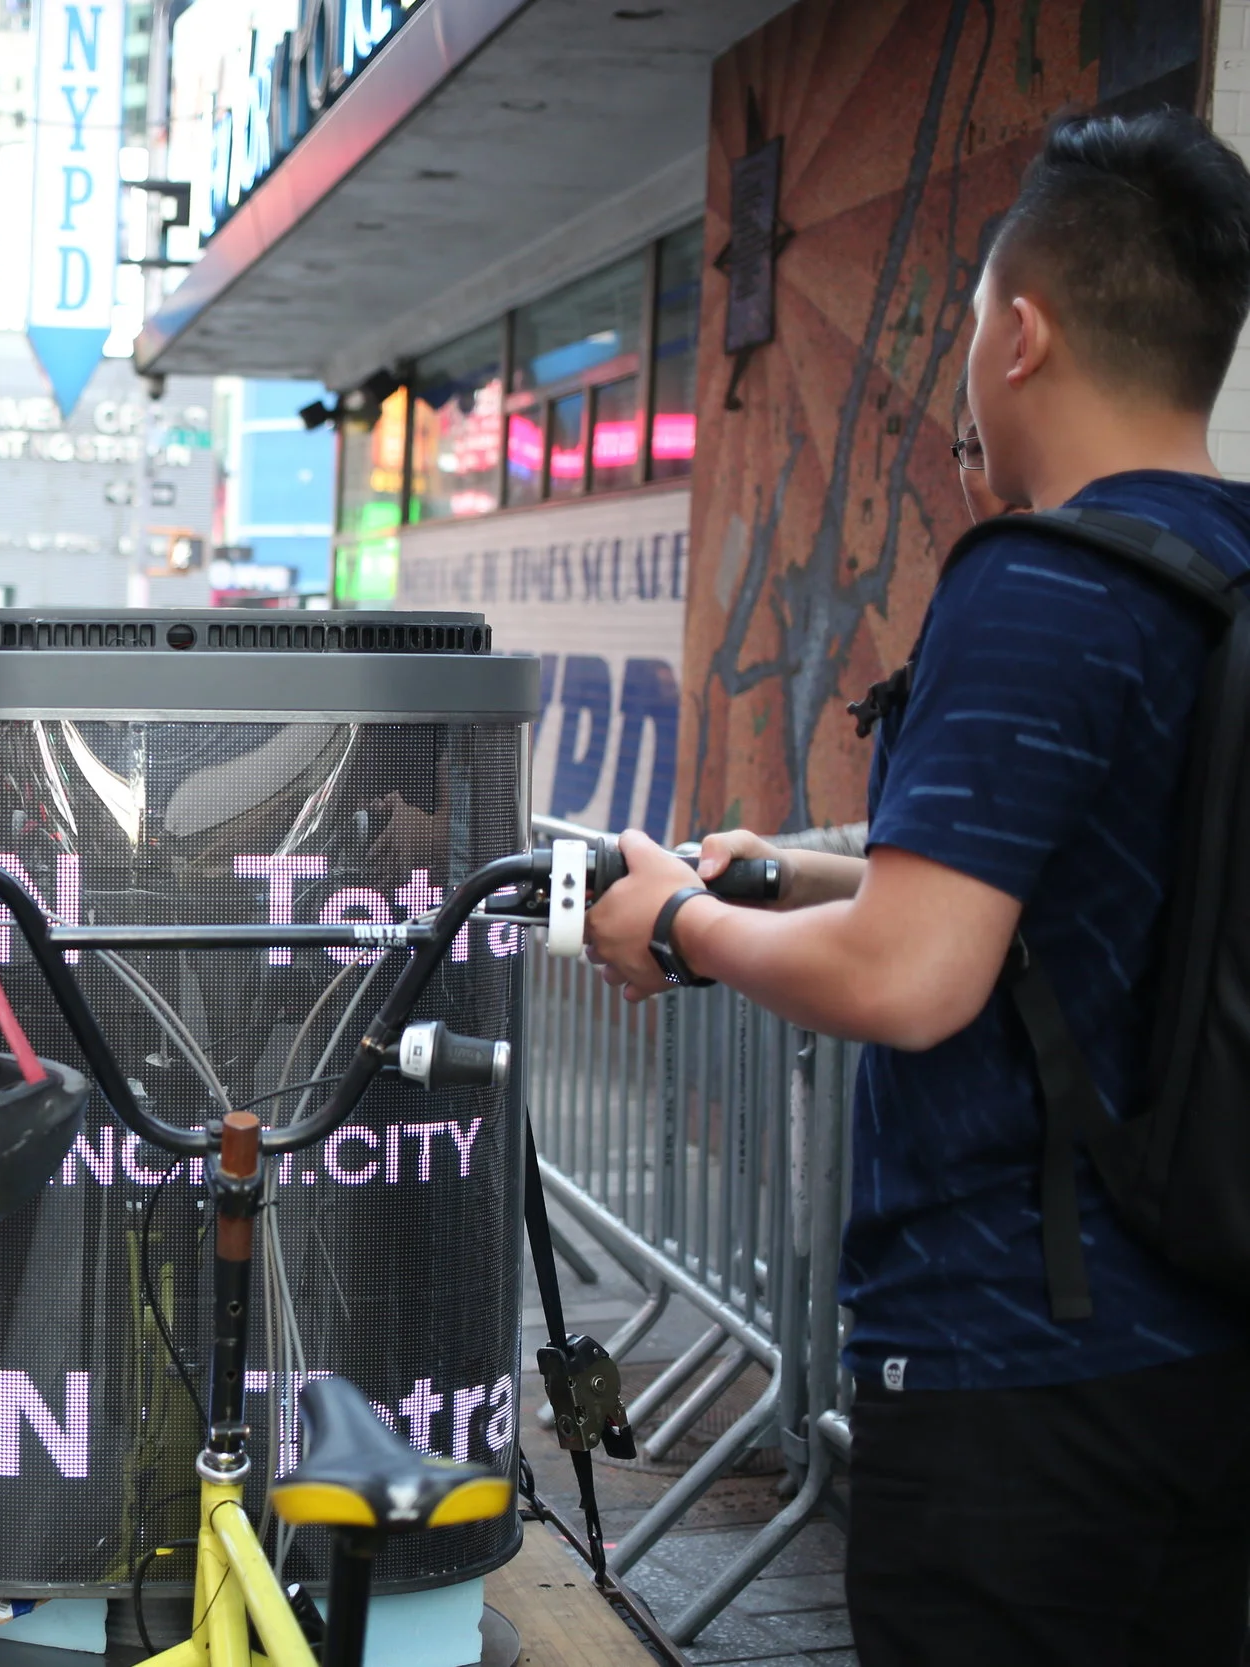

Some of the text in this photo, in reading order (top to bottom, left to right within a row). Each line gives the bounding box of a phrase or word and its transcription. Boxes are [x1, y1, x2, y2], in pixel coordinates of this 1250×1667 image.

[56, 5, 98, 311] NYPD
[353, 924, 408, 939] MOTO
[244, 1371, 513, 1479] Ttra
